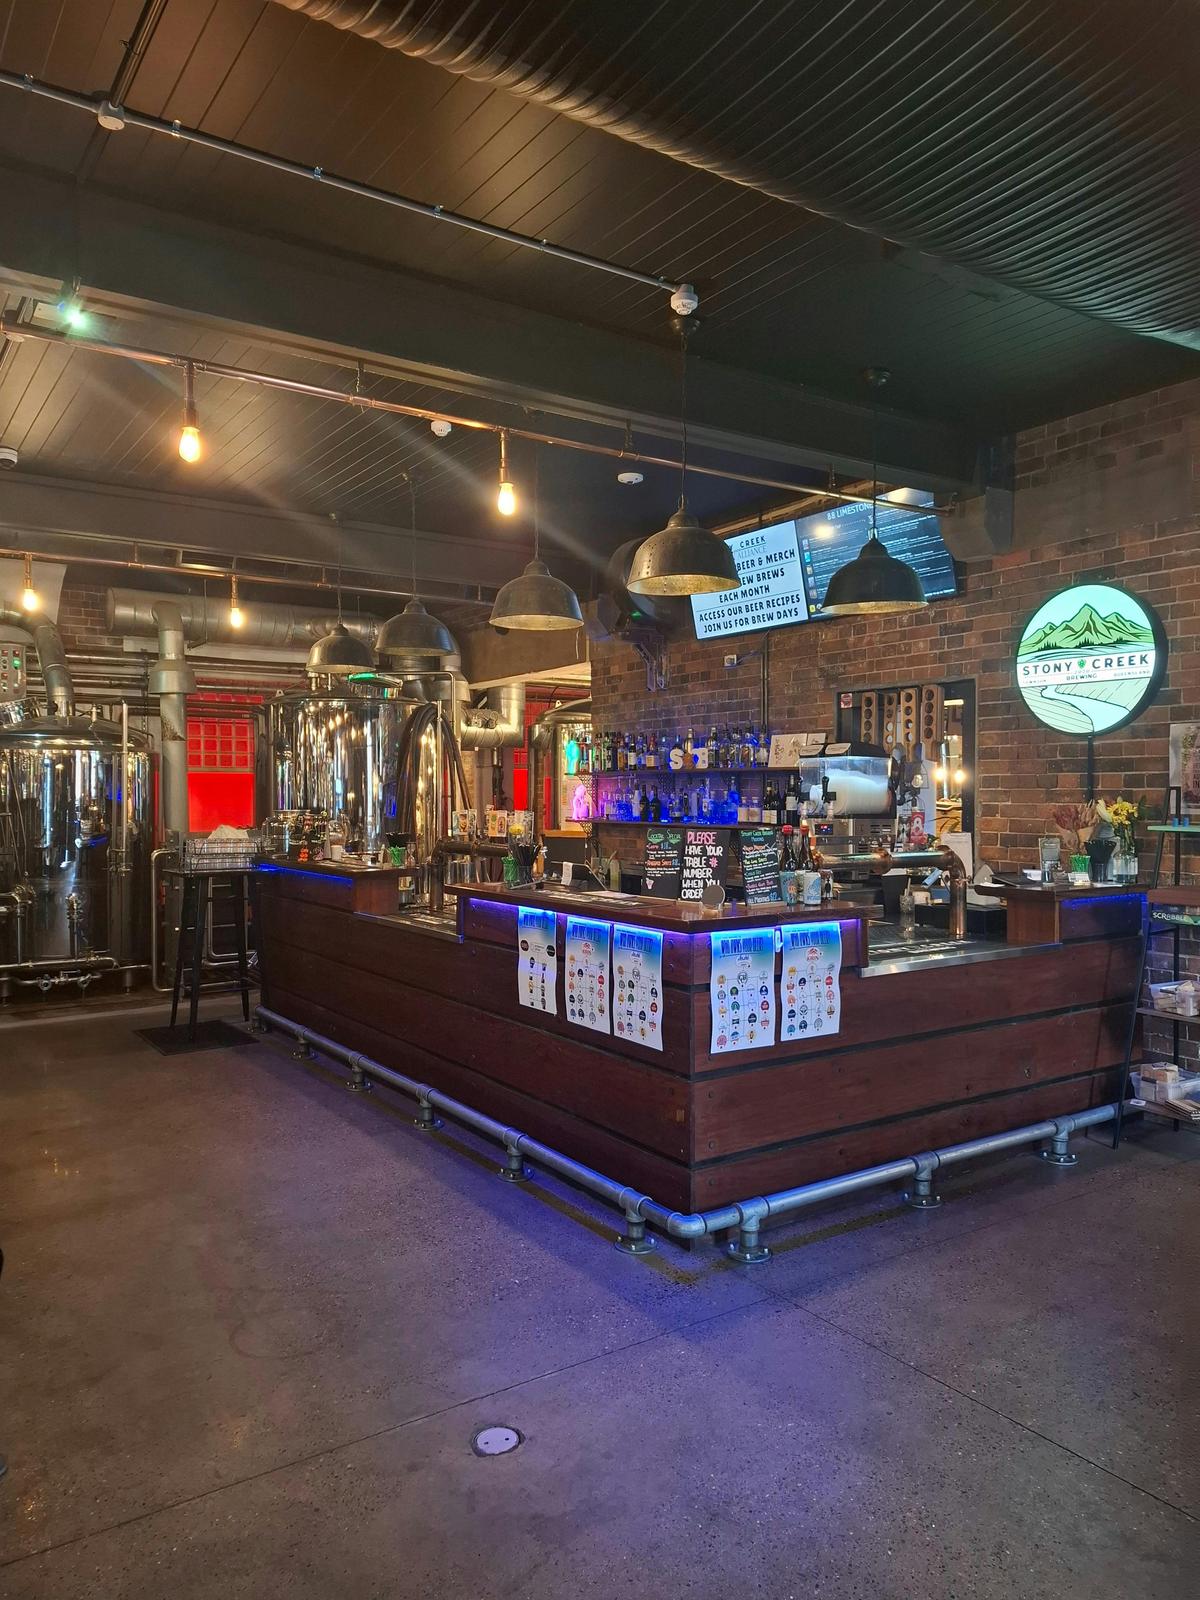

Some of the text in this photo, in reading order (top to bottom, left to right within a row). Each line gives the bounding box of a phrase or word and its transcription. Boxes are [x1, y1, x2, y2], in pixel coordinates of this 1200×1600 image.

[826, 511, 836, 520] 88
[740, 536, 766, 548] CREEK
[736, 549, 796, 571] BEER & MERCH
[742, 568, 785, 586] EW BREWS
[719, 584, 770, 603] EACH MONTH
[699, 594, 800, 622] ACCESS OUR BEER RECIPES
[704, 607, 799, 633] JOIN US FOR BREW DAYS
[1023, 654, 1149, 676] STONY CREEK
[1066, 672, 1098, 681] BREWING
[687, 832, 717, 845] PLEASE
[685, 845, 704, 856] HAVE
[705, 845, 723, 856] YOUR
[684, 856, 707, 868] TABLE
[709, 856, 718, 868] #
[683, 868, 713, 878] NUMBER
[682, 879, 704, 888] WHEN
[681, 888, 704, 899] ORDER
